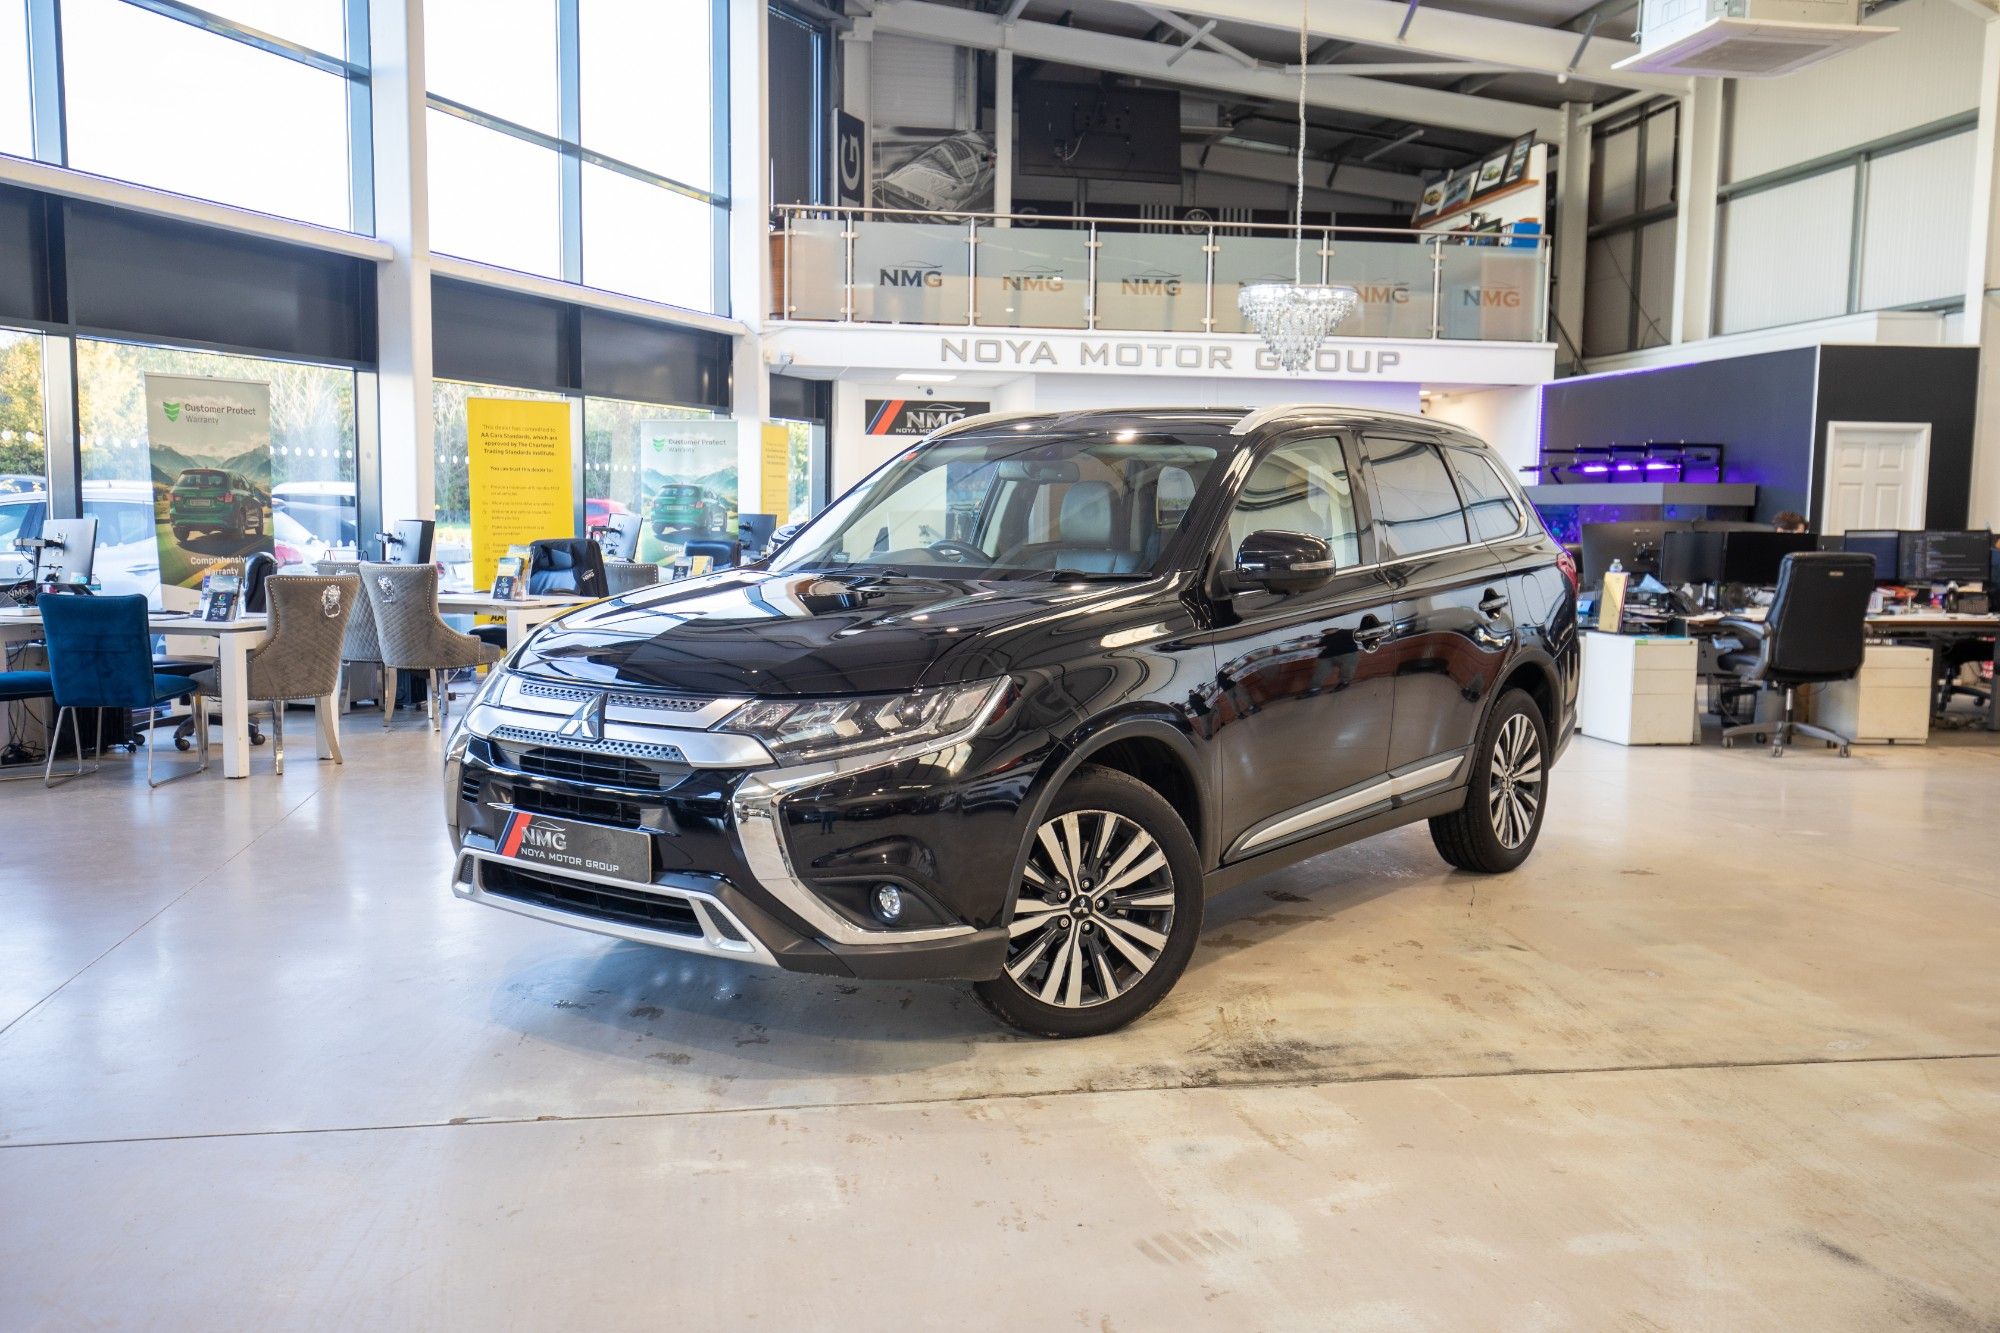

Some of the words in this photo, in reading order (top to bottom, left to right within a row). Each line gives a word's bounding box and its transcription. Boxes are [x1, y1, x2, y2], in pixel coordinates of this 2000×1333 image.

[879, 268, 943, 288] NMG
[1002, 275, 1064, 292] NMG
[1121, 278, 1182, 296] NMG
[1463, 288, 1521, 307] NMG
[941, 338, 1058, 365] NOYA
[1080, 341, 1233, 368] MOTOR
[1255, 348, 1400, 374] GOUP
[184, 403, 224, 414] Customer
[226, 406, 256, 416] Protect
[186, 415, 219, 425] Warranty
[190, 555, 248, 568] Comprehensiv
[204, 567, 239, 577] Warranty
[7, 587, 29, 597] NMG
[520, 826, 567, 851] NMG
[520, 847, 546, 859] NOYA
[548, 853, 582, 866] MOTOR
[585, 859, 620, 872] GROUP
